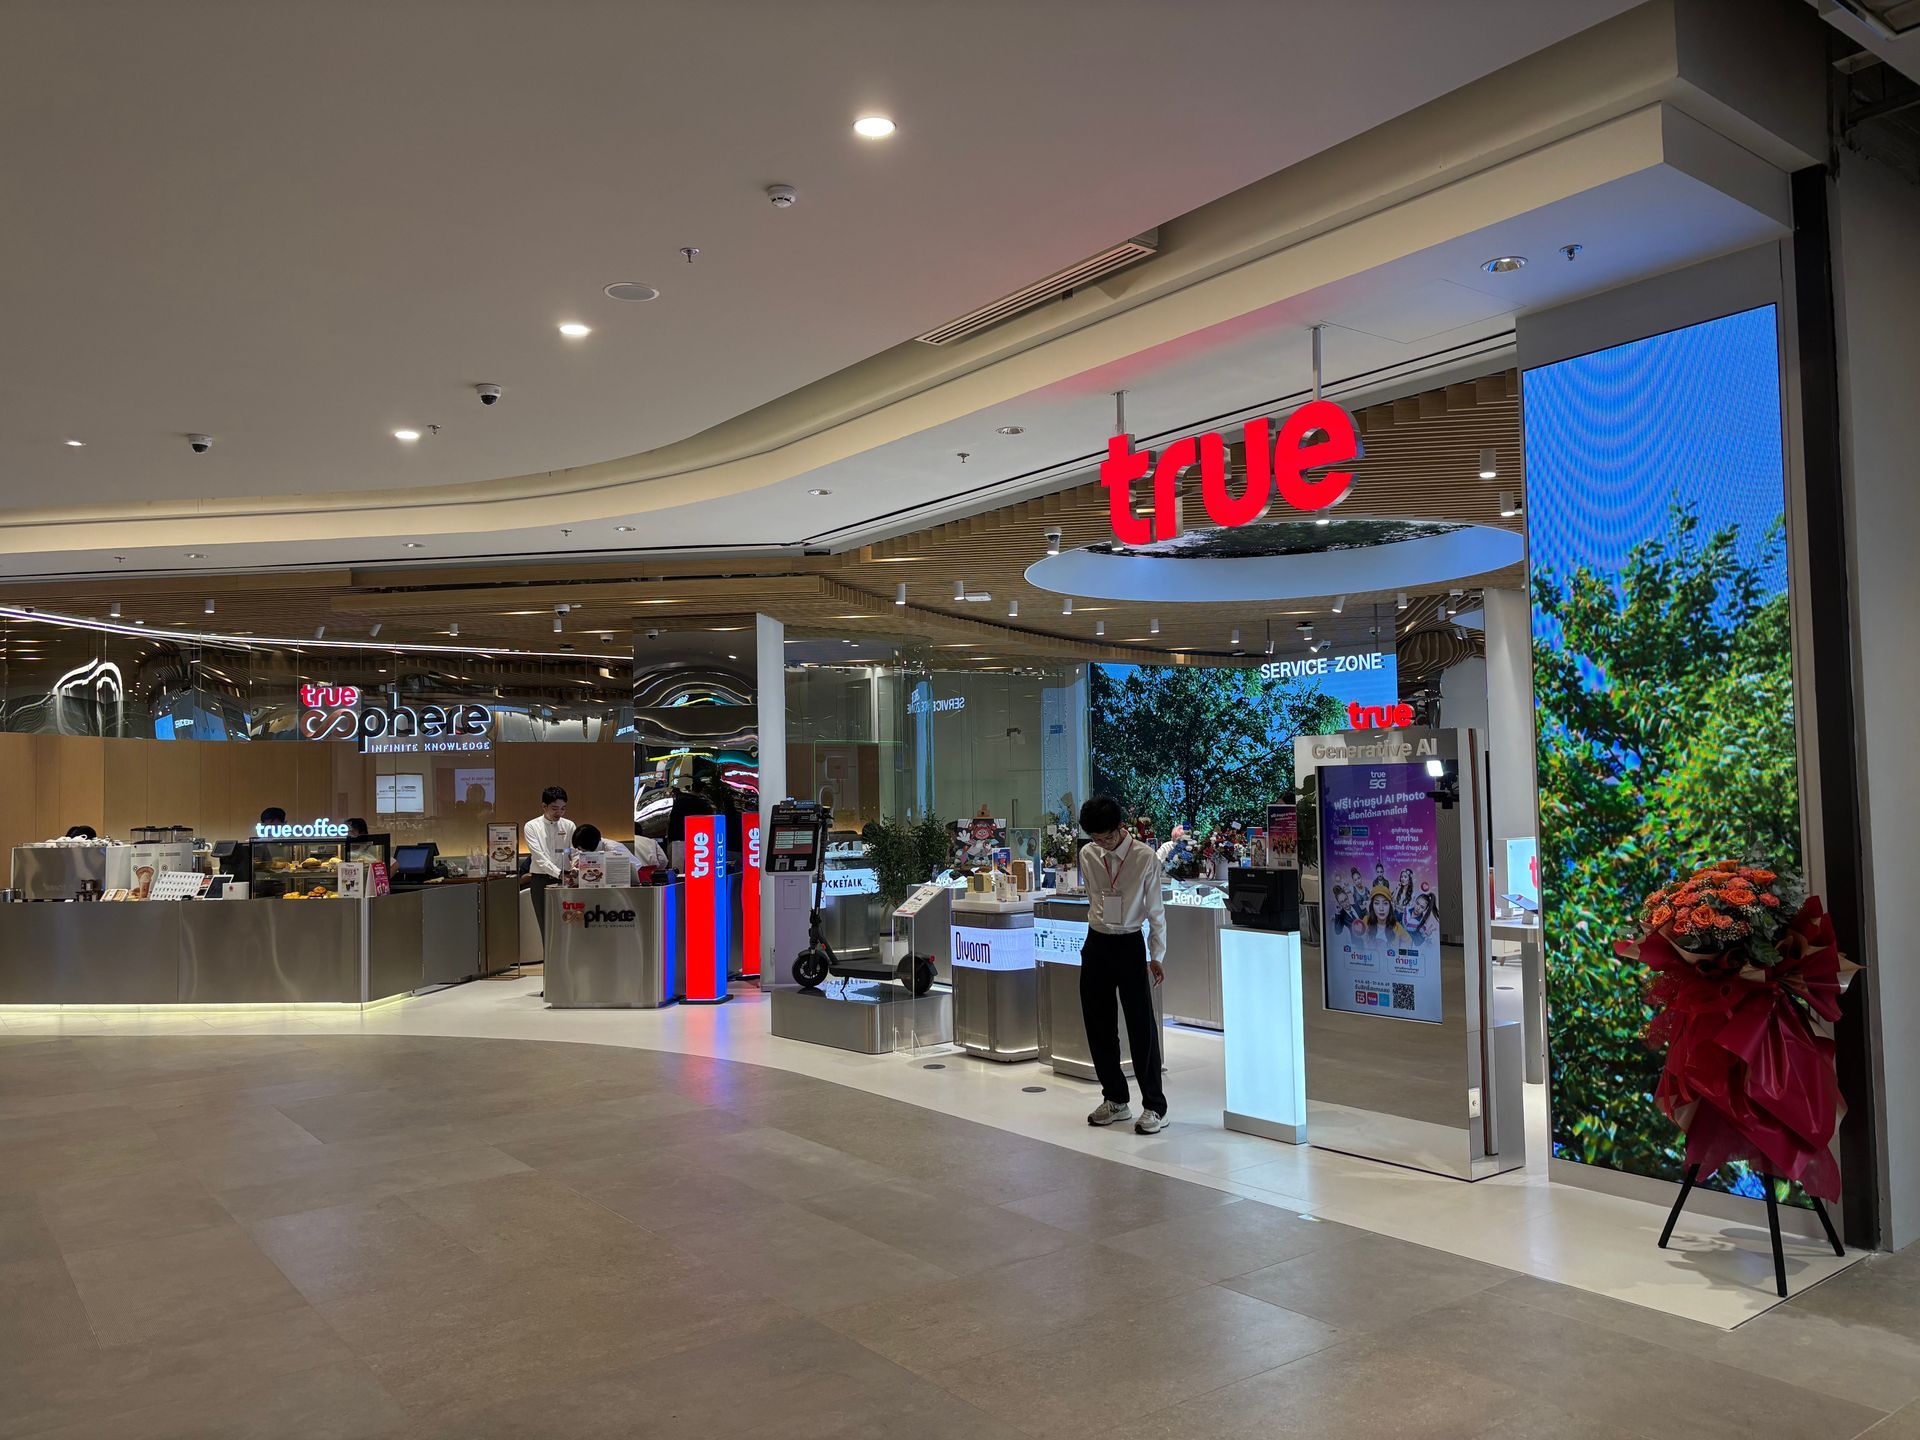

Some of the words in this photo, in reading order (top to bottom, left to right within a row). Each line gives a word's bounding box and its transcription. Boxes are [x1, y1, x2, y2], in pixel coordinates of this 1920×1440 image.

[1100, 400, 1357, 546] true
[1260, 657, 1328, 679] SERVICE
[1335, 652, 1383, 673] ZONE
[300, 684, 361, 708] true
[1347, 701, 1414, 730] true
[371, 743, 419, 753] INFINITE
[424, 741, 490, 751] KNOWLEDGE
[1311, 739, 1412, 760] Generative
[1416, 737, 1438, 756] AI
[1369, 778, 1387, 789] 5G
[1396, 791, 1425, 803] Photo
[255, 817, 349, 838] truecoffee
[691, 832, 709, 878] true
[716, 833, 724, 878] dtac
[562, 901, 586, 911] true
[1172, 889, 1202, 906] Reno
[955, 931, 991, 964] Divoom
